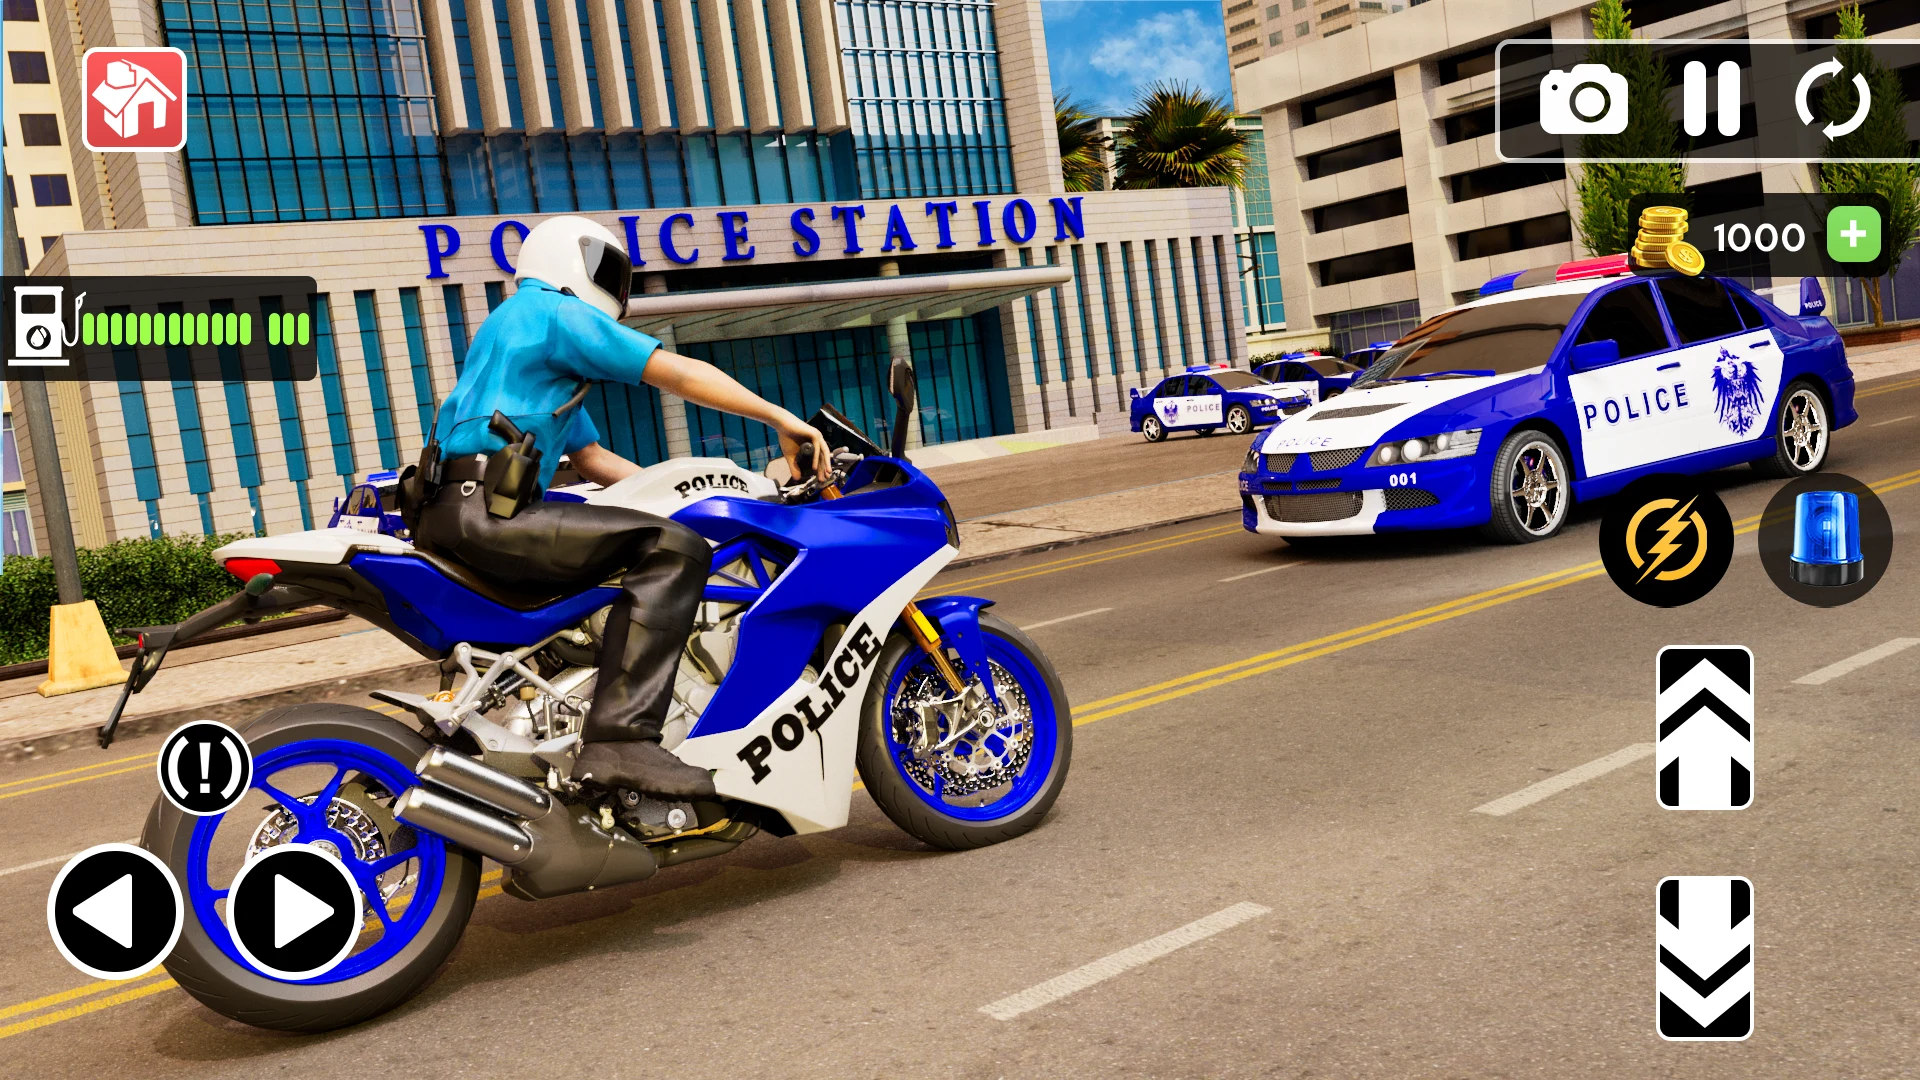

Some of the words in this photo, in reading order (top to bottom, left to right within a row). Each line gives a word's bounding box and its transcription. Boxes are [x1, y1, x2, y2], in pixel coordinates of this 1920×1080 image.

[418, 211, 756, 280] POICE
[791, 196, 1086, 257] STATION
[1186, 403, 1221, 413] POLICE
[1583, 382, 1690, 431] POLICE
[1277, 437, 1332, 450] POLICE
[674, 474, 749, 499] POLICE
[1389, 472, 1417, 487] 001
[736, 622, 883, 785] POLICE
